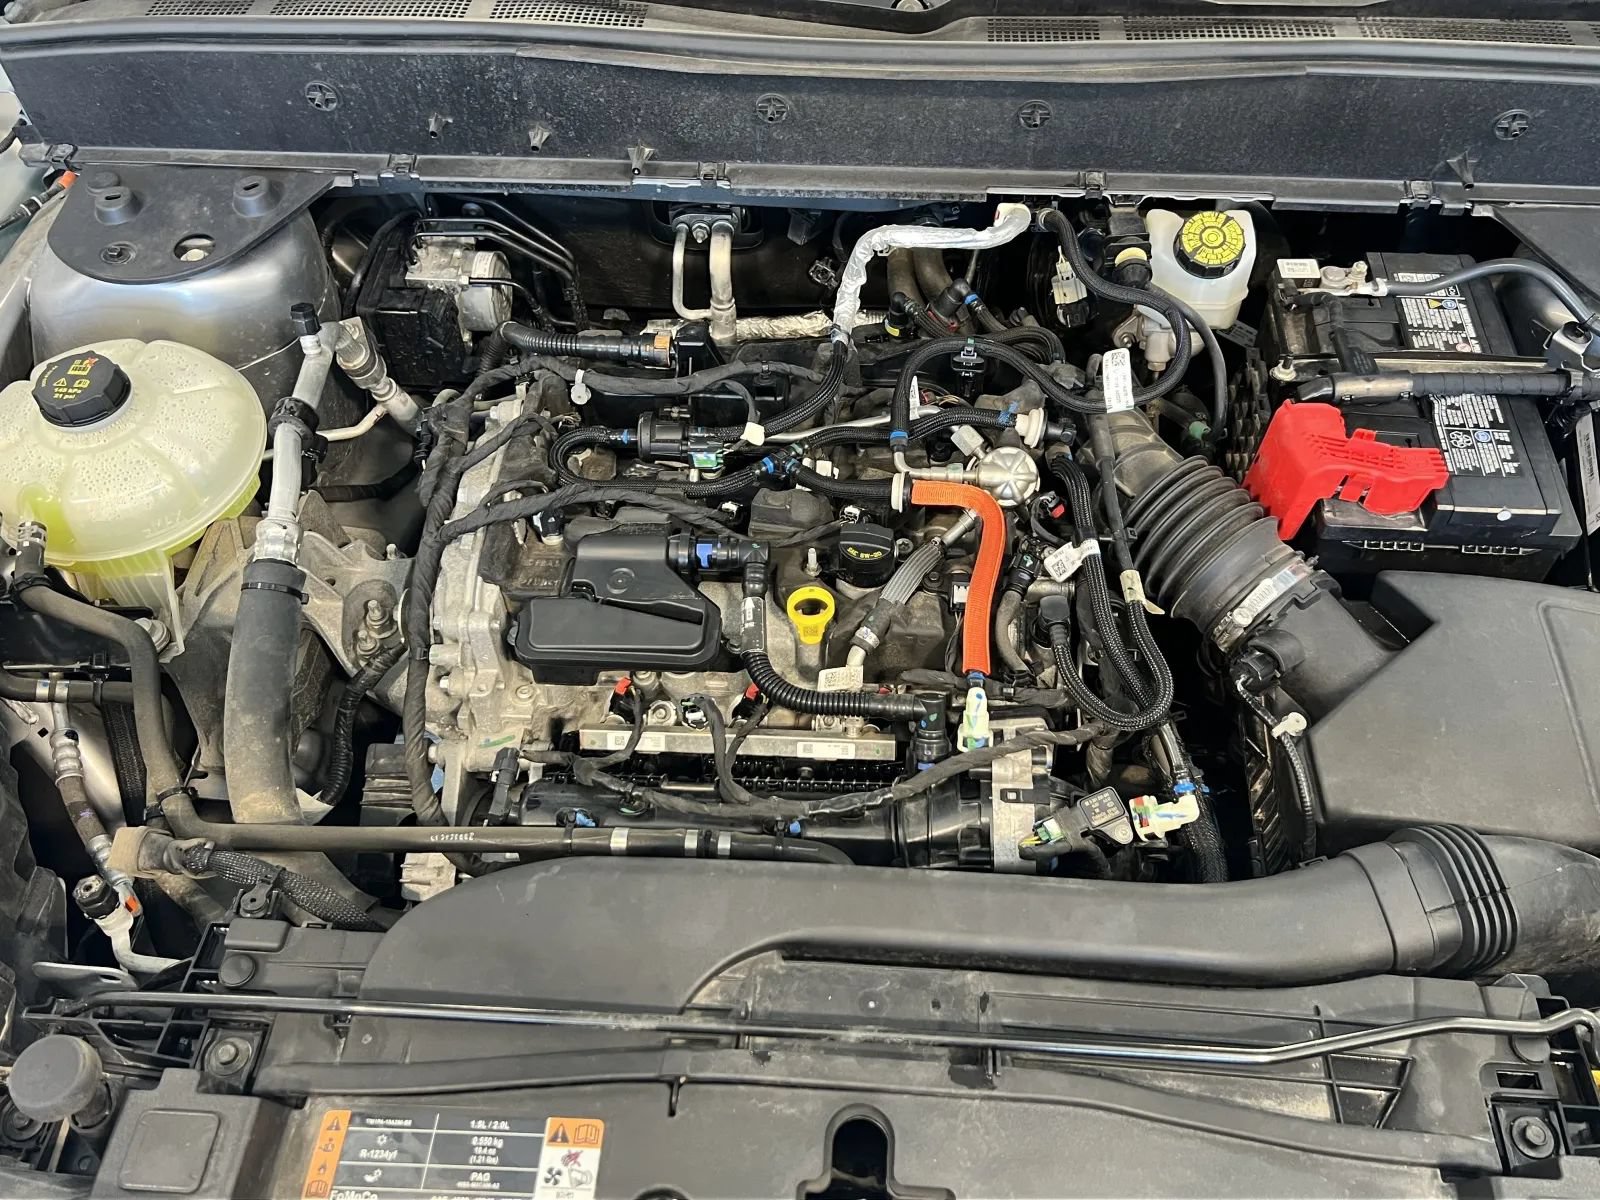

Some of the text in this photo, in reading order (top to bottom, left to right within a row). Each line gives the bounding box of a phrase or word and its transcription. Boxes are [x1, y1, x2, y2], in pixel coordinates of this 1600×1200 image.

[492, 1120, 510, 1131] 2.0L
[493, 1136, 504, 1149] kg
[359, 1148, 398, 1161] R-1234yf
[470, 1171, 491, 1182] PAG
[329, 1189, 378, 1200] FoMoCo
